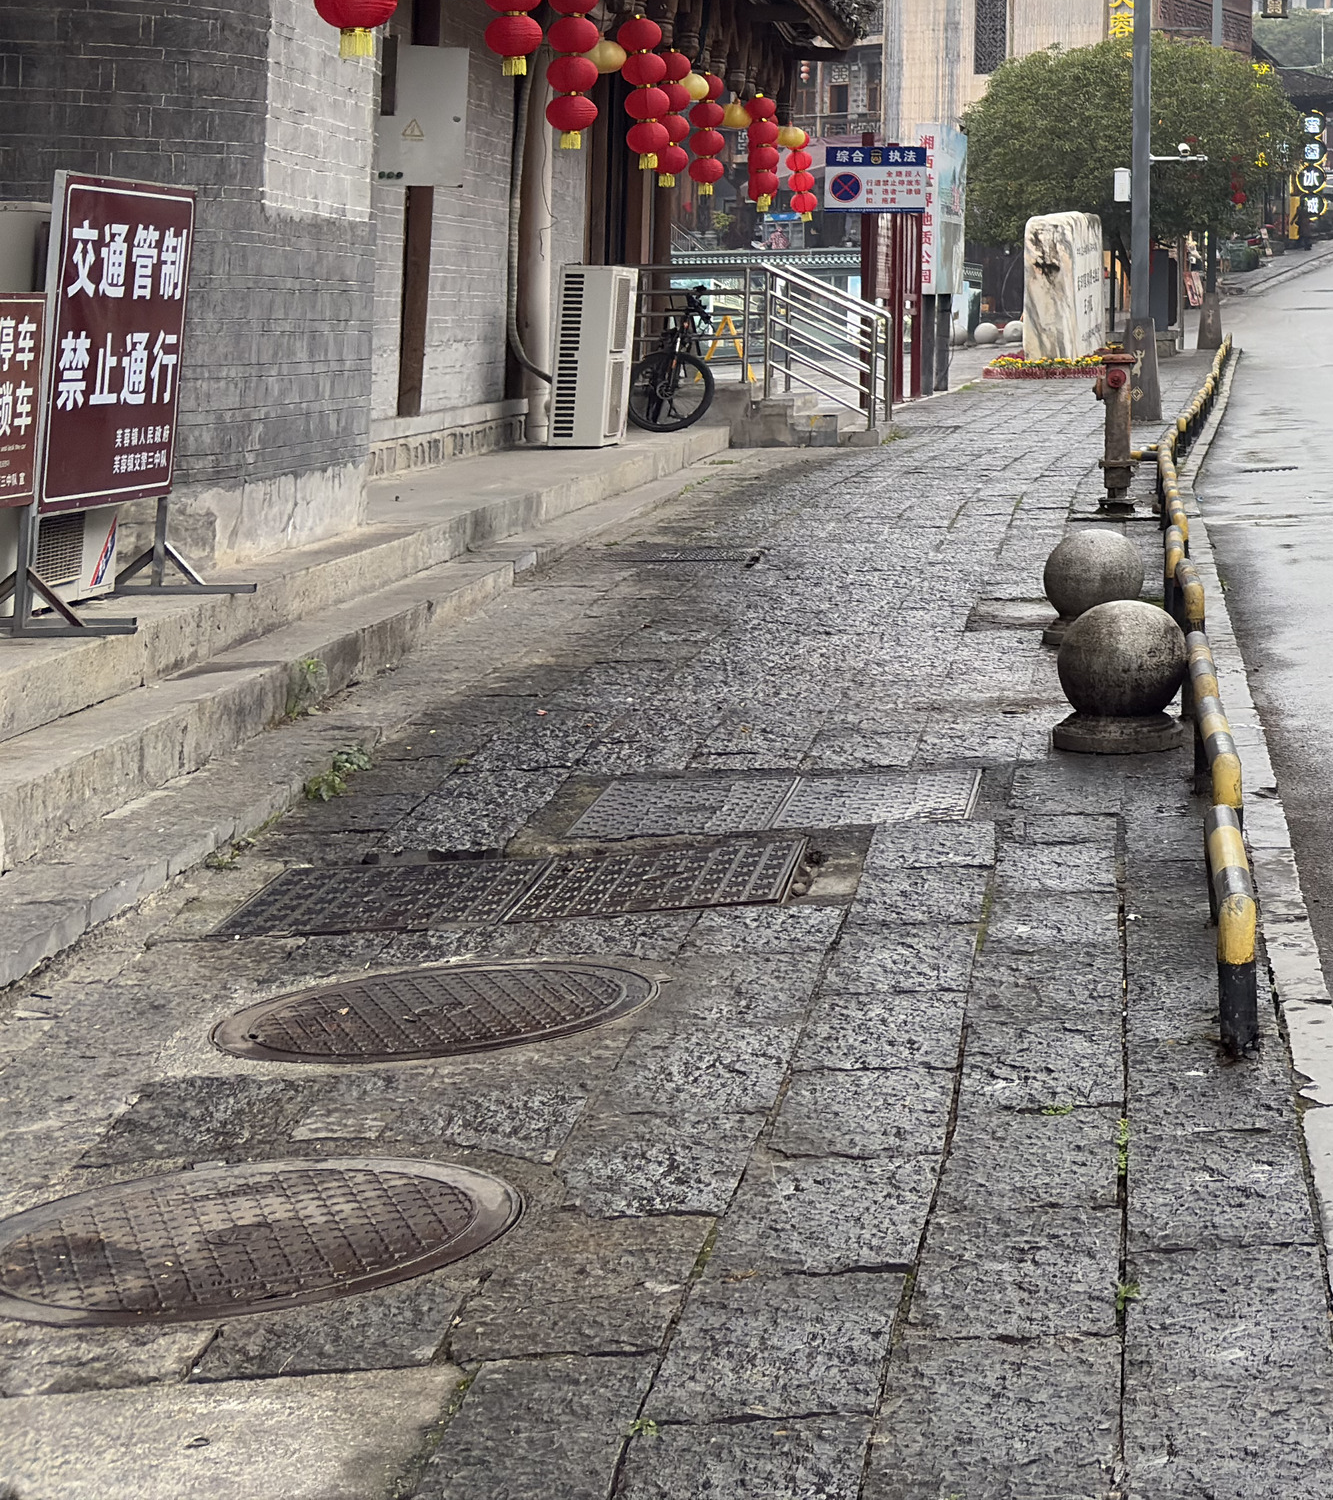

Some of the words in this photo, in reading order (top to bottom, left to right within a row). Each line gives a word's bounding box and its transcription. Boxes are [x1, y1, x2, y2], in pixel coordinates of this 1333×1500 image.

[836, 149, 865, 163] 综合
[888, 150, 917, 163] 执法
[67, 219, 188, 301] 交通管制
[0, 315, 37, 372] 停车
[56, 329, 178, 412] 禁止通行
[115, 424, 171, 449] 芙蓉镇人民政府
[113, 449, 168, 475] 芙蓉镇交警三中队
